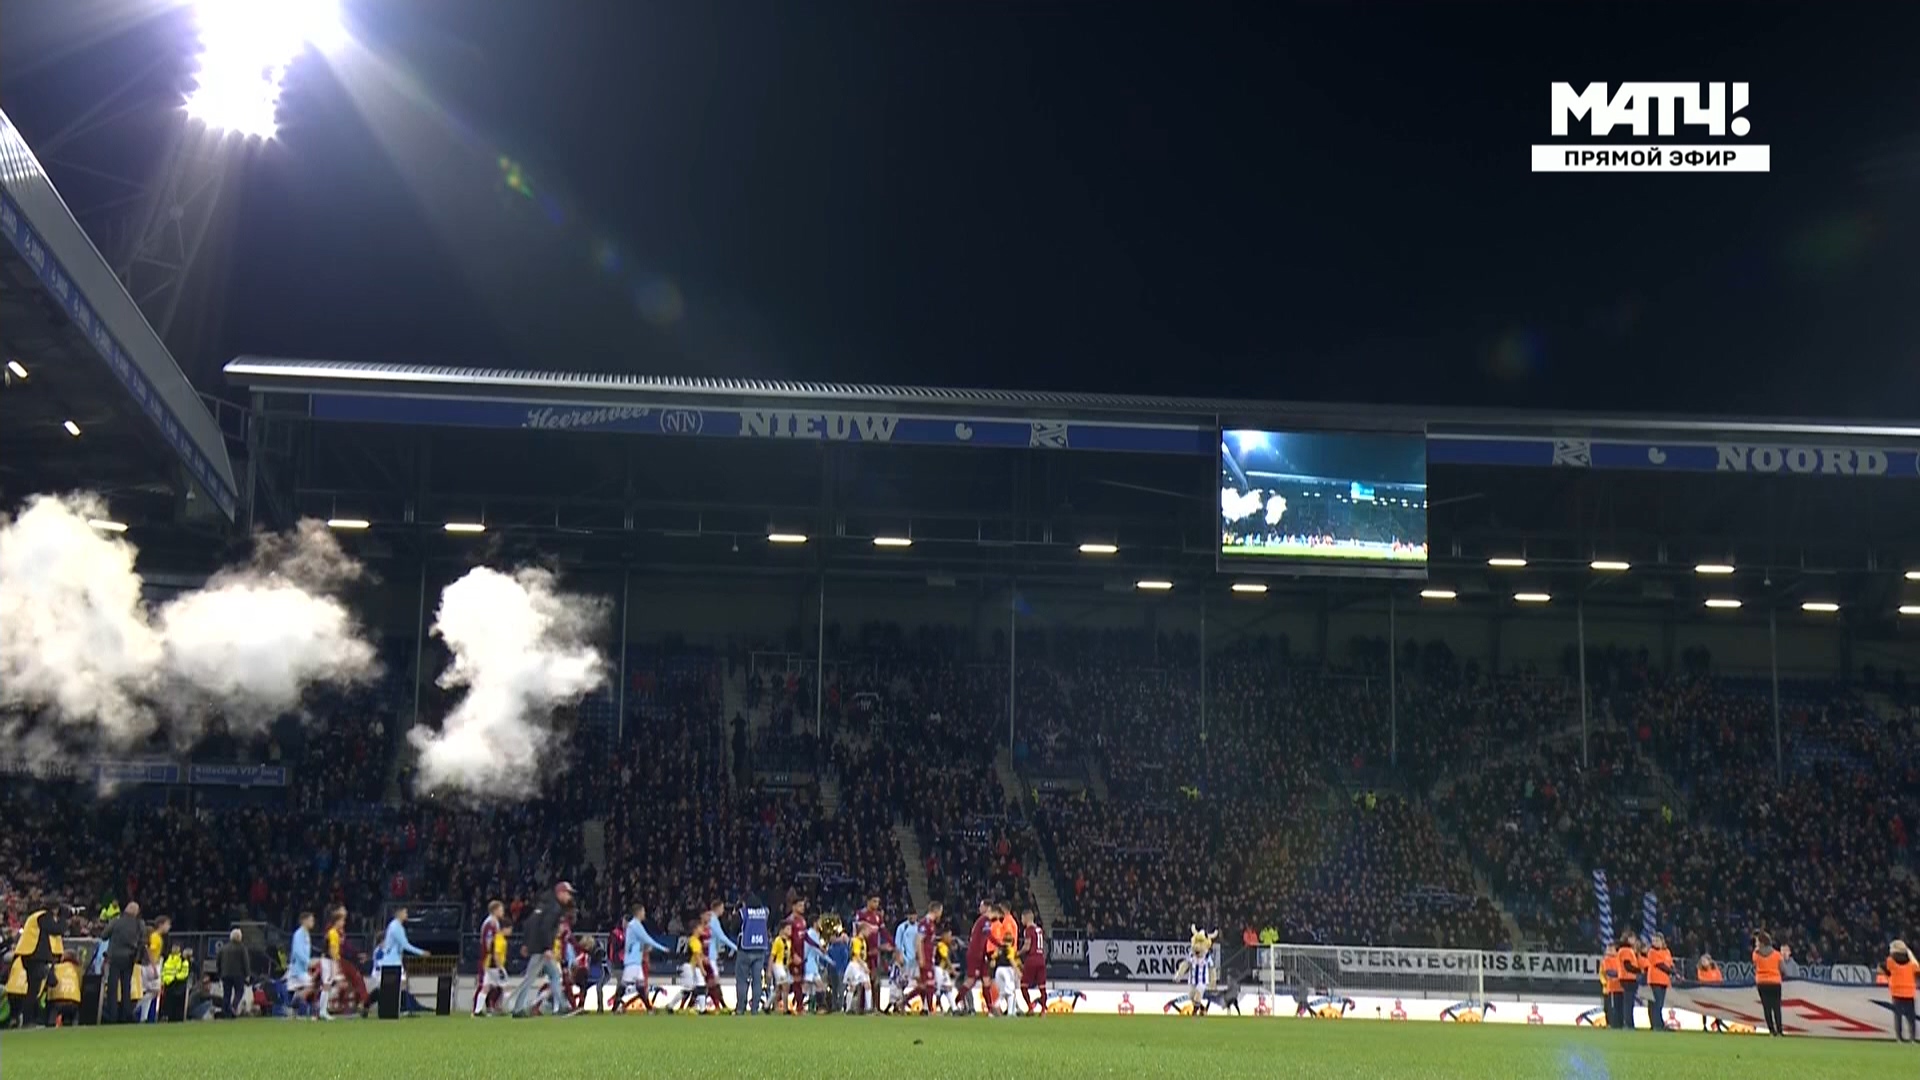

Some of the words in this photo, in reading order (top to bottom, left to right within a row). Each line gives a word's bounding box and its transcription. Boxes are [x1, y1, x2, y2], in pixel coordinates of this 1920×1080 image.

[739, 411, 899, 441] NIEUW
[1716, 446, 1888, 474] NOORD
[1136, 944, 1163, 956] STAY
